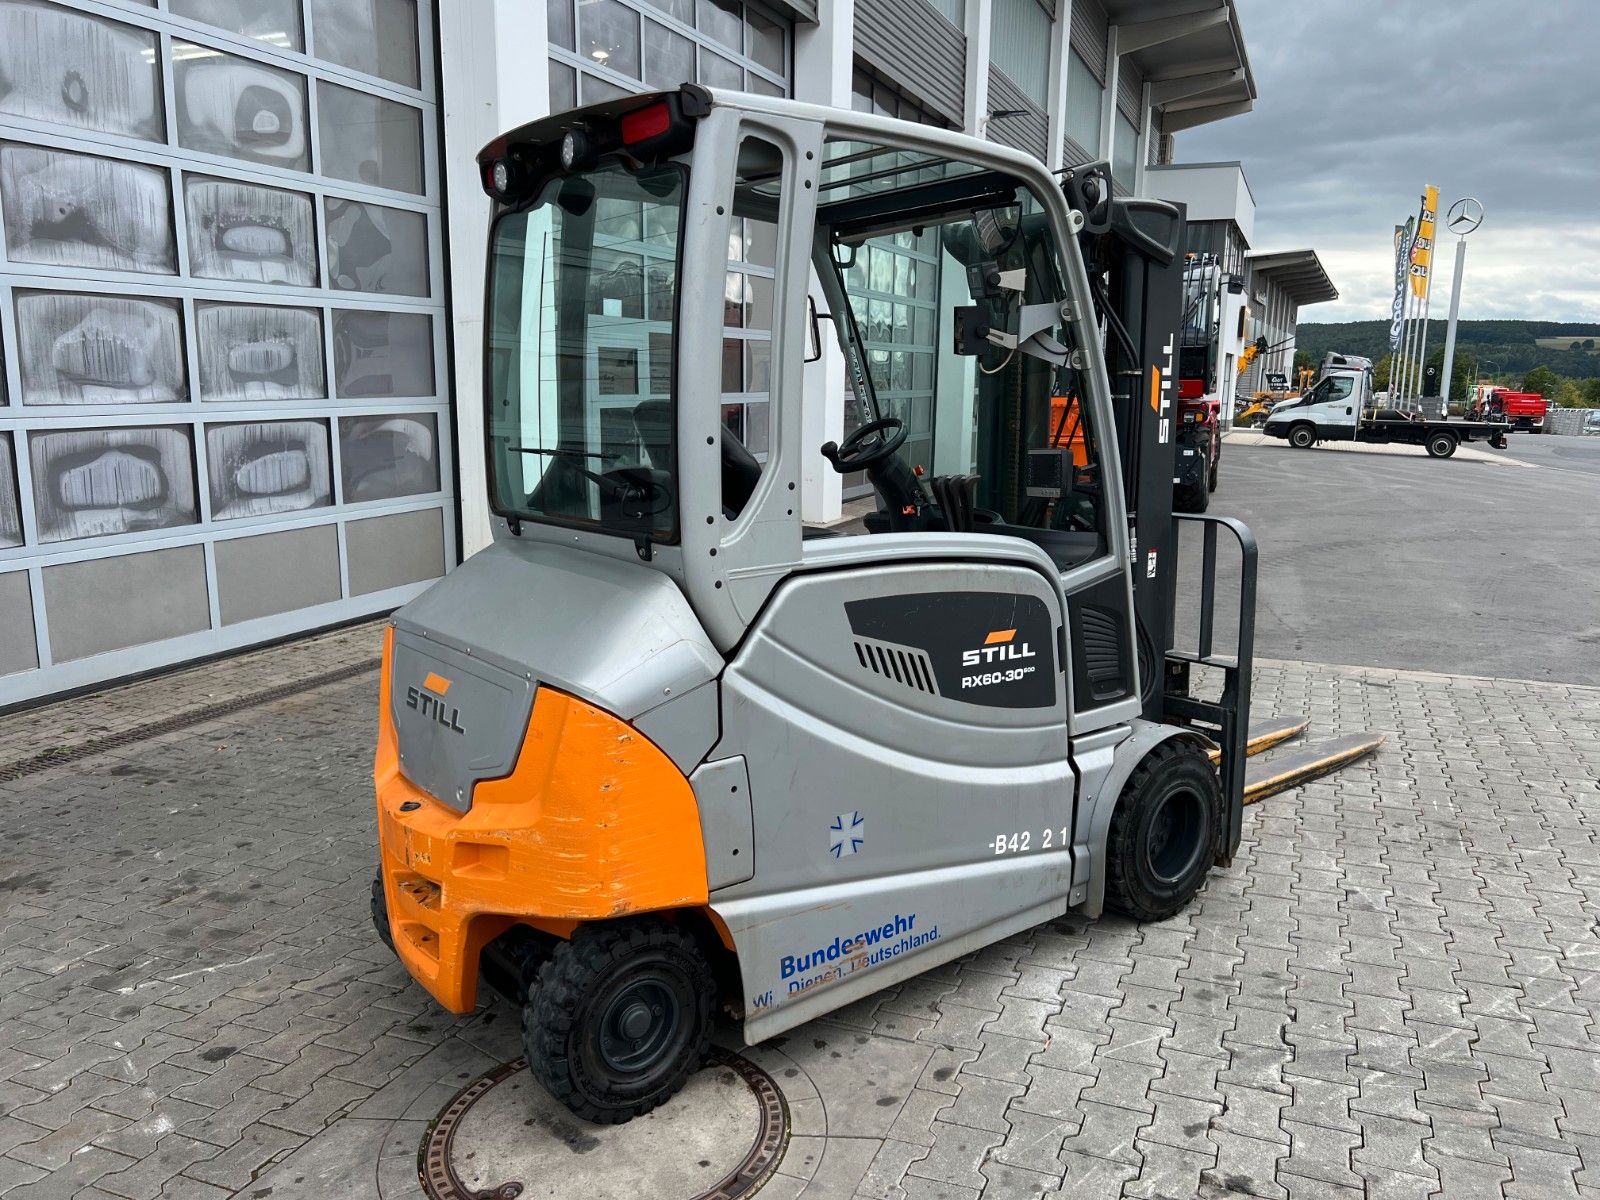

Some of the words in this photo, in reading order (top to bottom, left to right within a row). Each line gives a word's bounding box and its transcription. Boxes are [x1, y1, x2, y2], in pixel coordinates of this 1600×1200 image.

[1159, 333, 1174, 444] STILL
[962, 643, 1036, 667] STILL
[406, 685, 466, 735] STILL
[780, 913, 916, 980] Bundeswehr
[851, 925, 942, 971] eutschland.
